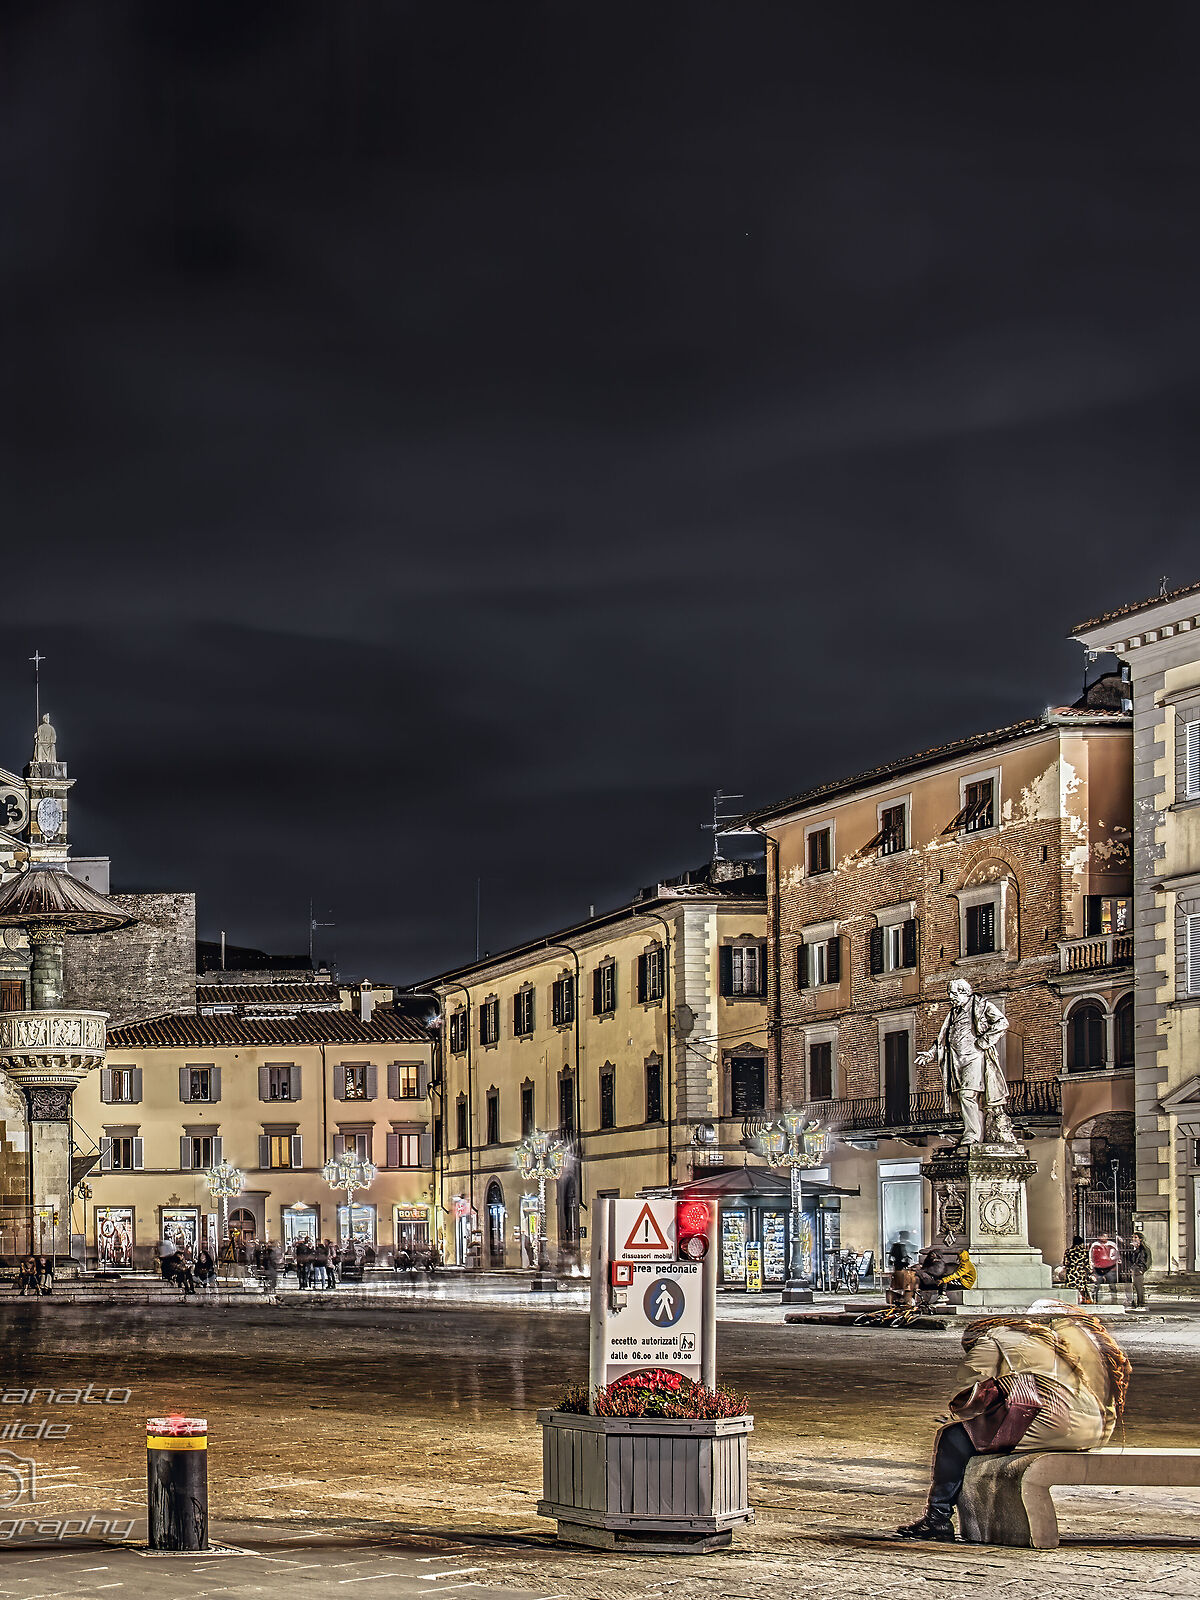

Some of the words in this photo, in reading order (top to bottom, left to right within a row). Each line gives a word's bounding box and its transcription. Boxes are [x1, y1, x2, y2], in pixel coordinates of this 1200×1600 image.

[621, 1252, 652, 1260] dissuasori
[633, 1265, 652, 1273] area
[655, 1264, 698, 1274] pedonale
[610, 1336, 638, 1346] eccetto
[641, 1336, 679, 1346] autorizzati
[610, 1351, 629, 1360] dalle
[655, 1351, 669, 1360] alle
